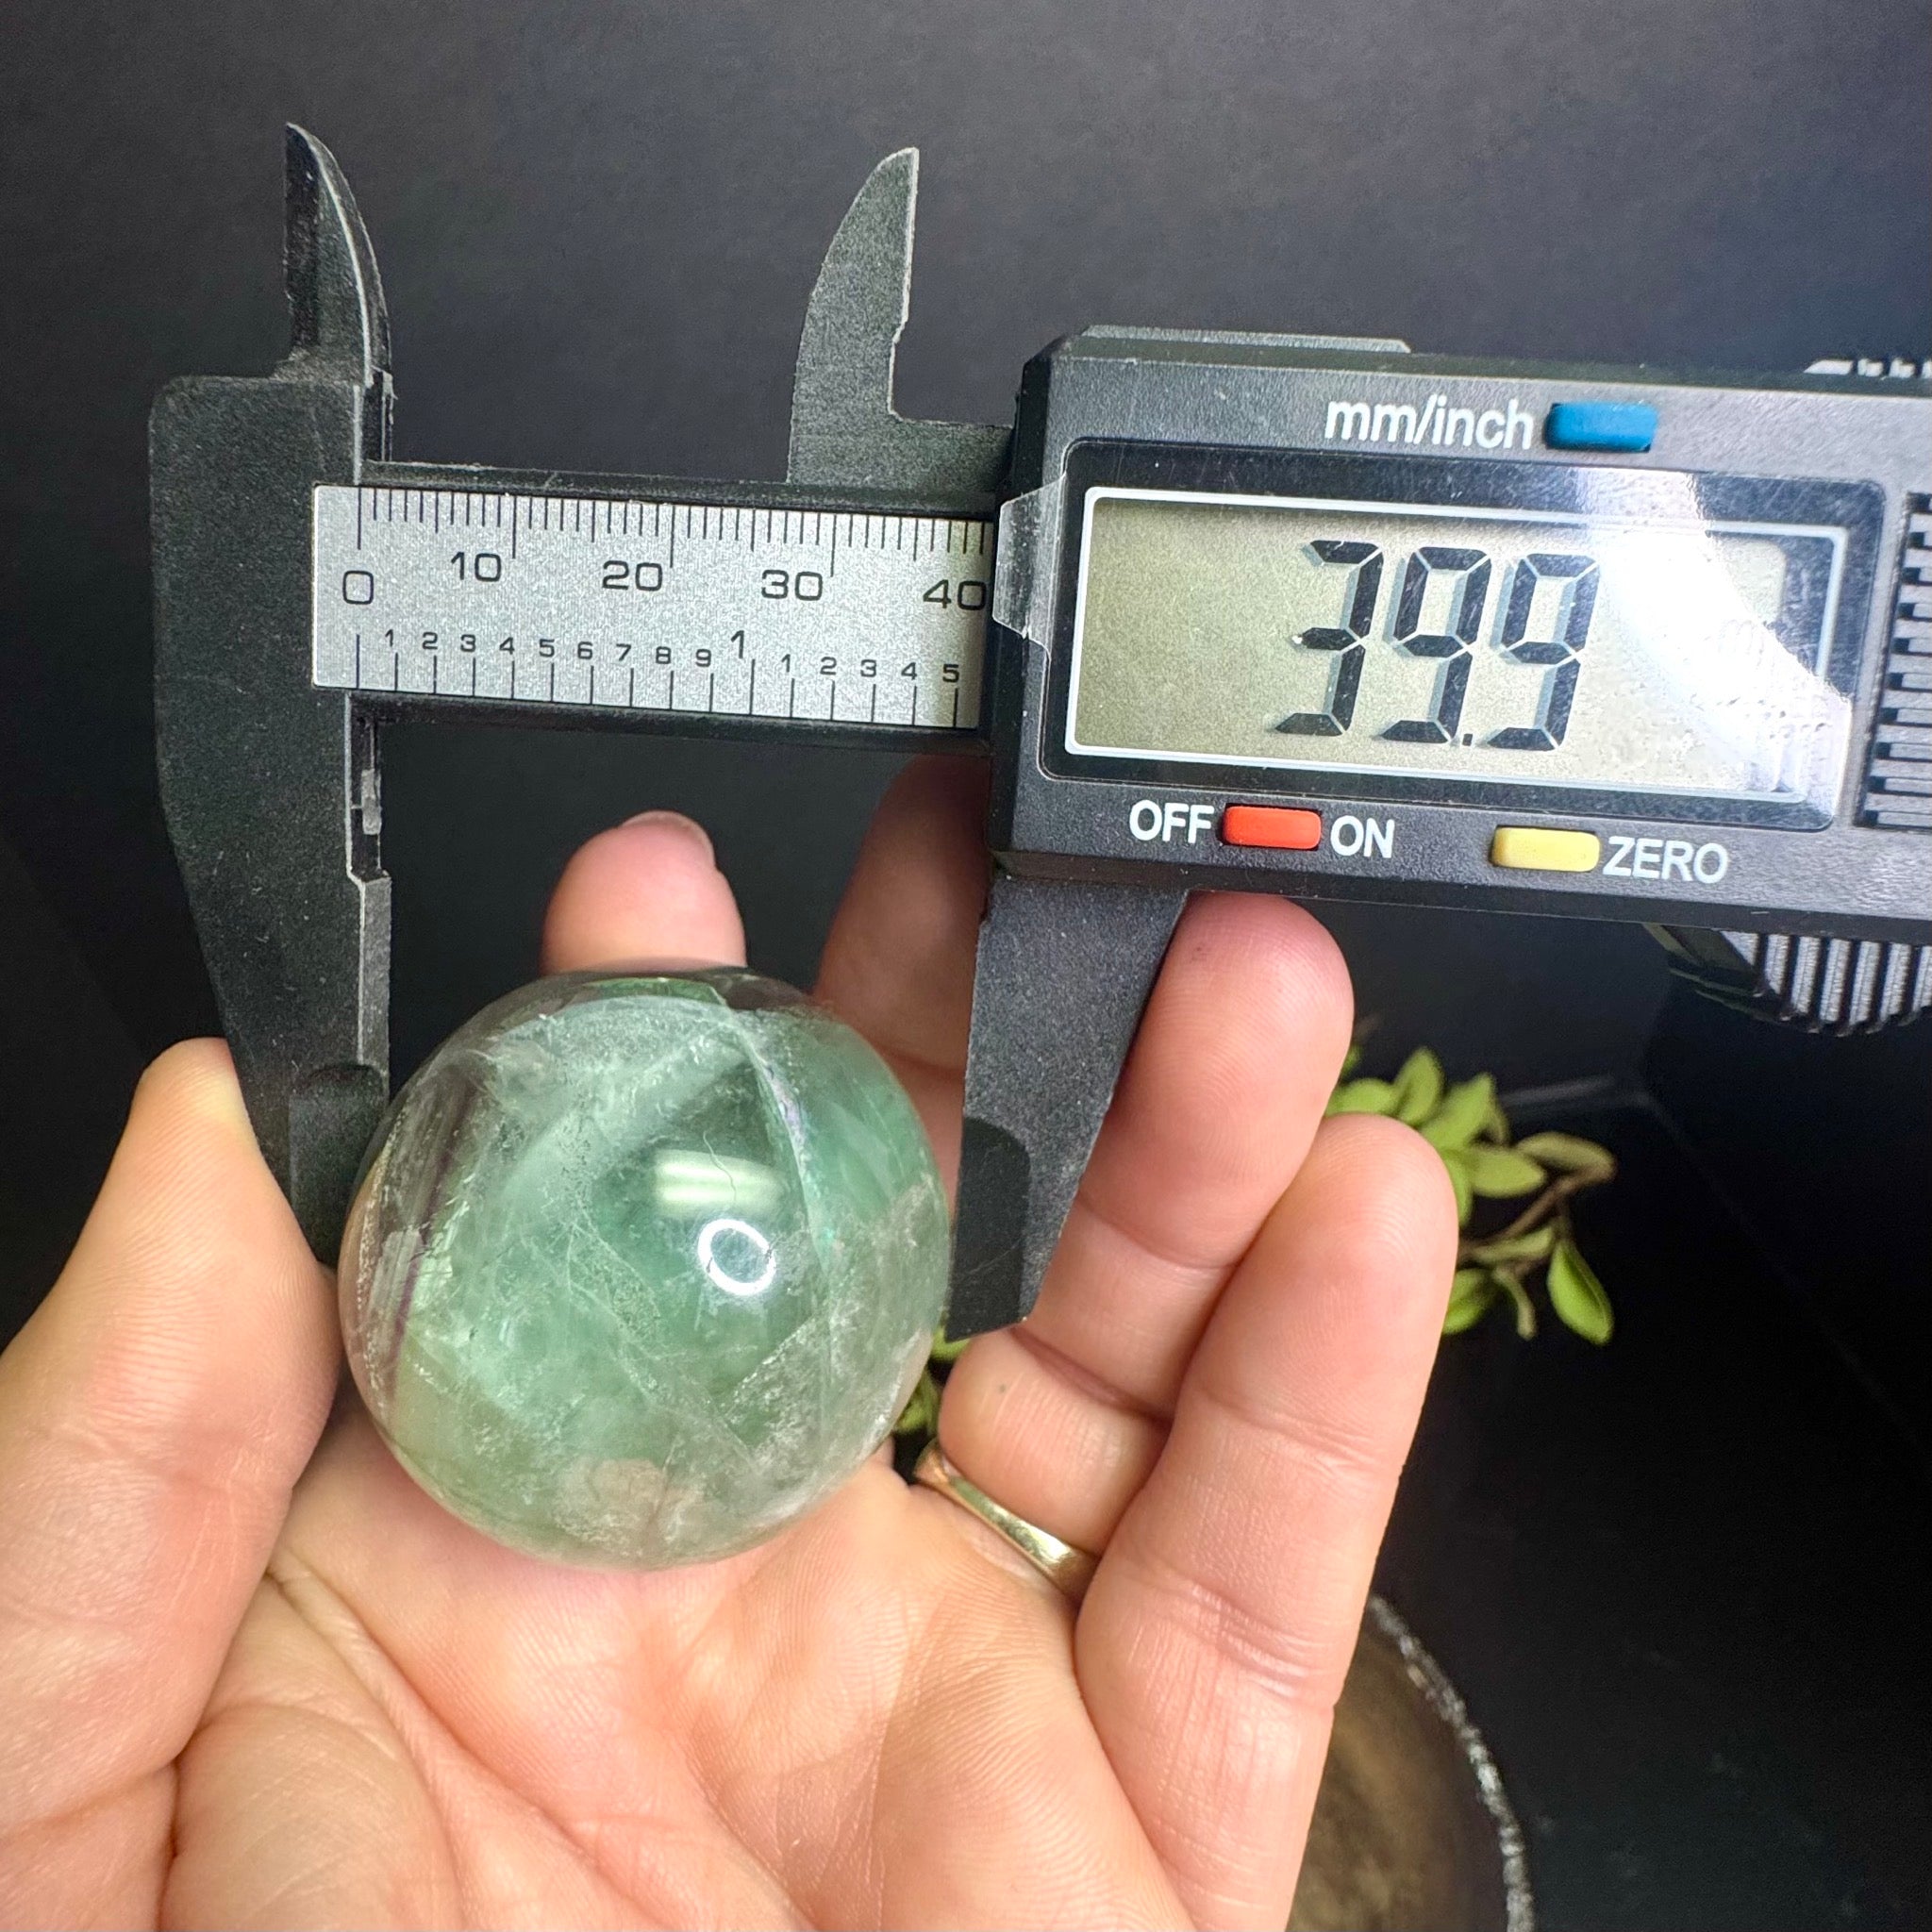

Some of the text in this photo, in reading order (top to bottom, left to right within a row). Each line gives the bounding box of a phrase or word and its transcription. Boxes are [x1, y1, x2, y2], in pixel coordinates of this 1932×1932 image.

[1324, 393, 1534, 450] mm/inch
[342, 551, 987, 610] 0 10 20 30 40
[384, 629, 959, 683] 1 2 3 4 5 6 7 8 9 1 1 2 3 4 5
[1274, 540, 1600, 752] 39.9
[1129, 799, 1214, 844] OFF
[1330, 815, 1395, 859] ON
[1602, 835, 1729, 885] ZERO
